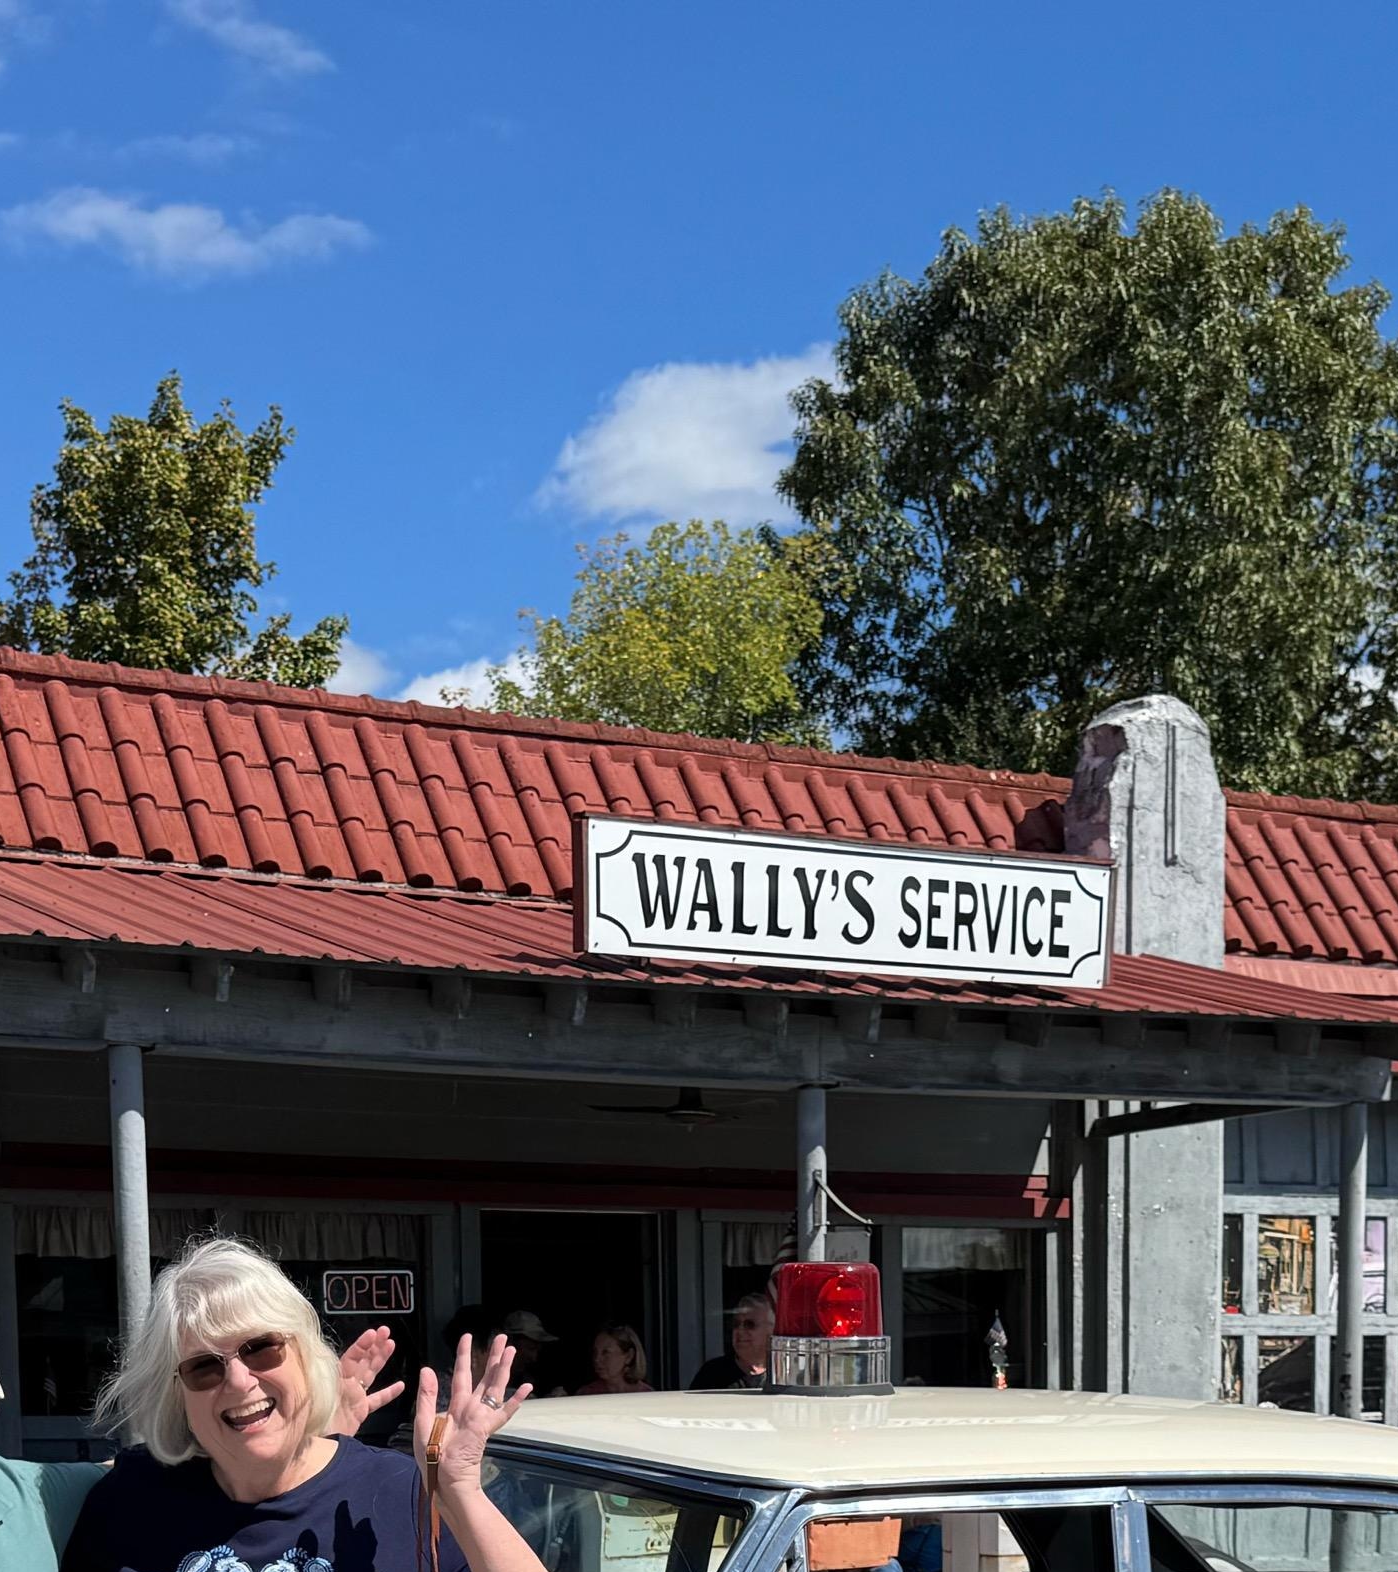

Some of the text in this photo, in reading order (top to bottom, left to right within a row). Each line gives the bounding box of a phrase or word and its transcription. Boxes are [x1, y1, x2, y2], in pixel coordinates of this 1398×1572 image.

[631, 852, 1072, 959] WALLY'S SERVICE
[327, 1275, 410, 1310] OPEN
